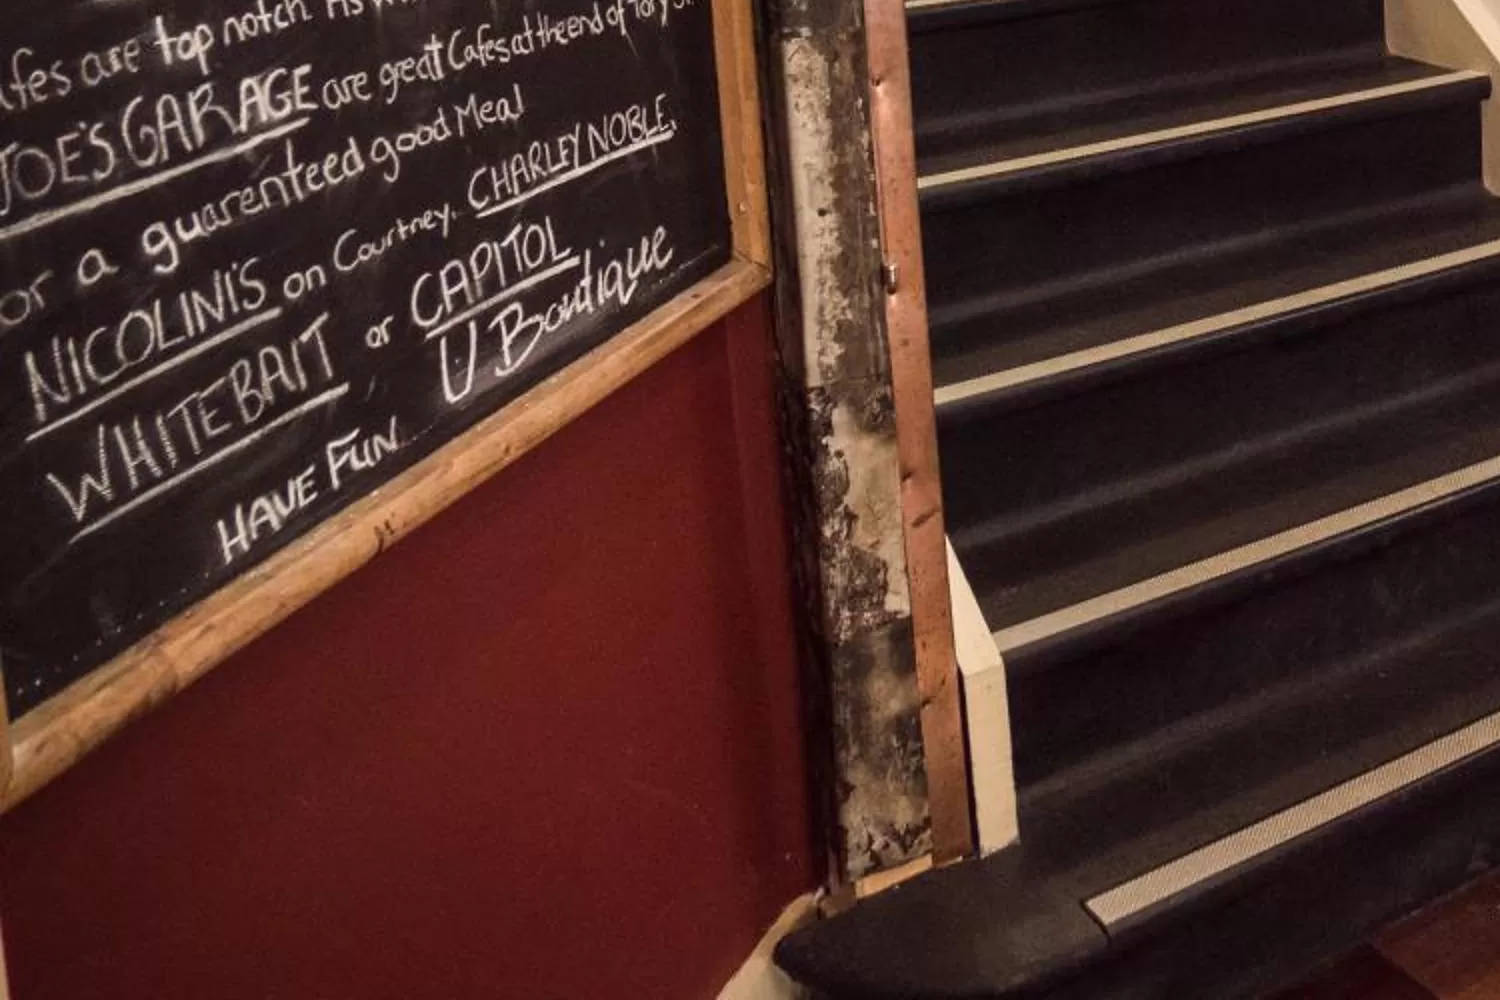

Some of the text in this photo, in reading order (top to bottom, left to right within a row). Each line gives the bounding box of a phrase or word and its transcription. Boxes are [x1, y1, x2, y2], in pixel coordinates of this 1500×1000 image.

[81, 38, 140, 86] are
[153, 14, 214, 76] top
[121, 63, 319, 168] GARAGE
[322, 71, 373, 110] are
[379, 35, 446, 105] great
[447, 23, 511, 70] Cafes
[76, 248, 120, 285] a
[369, 106, 451, 183] good
[453, 83, 525, 138] Meal
[282, 263, 328, 300] on
[467, 121, 582, 211] CHARLEY
[46, 214, 573, 522] WHITEBAIT or CAPITOL
[439, 319, 477, 404] U
[216, 414, 399, 566] HAVE FUN
